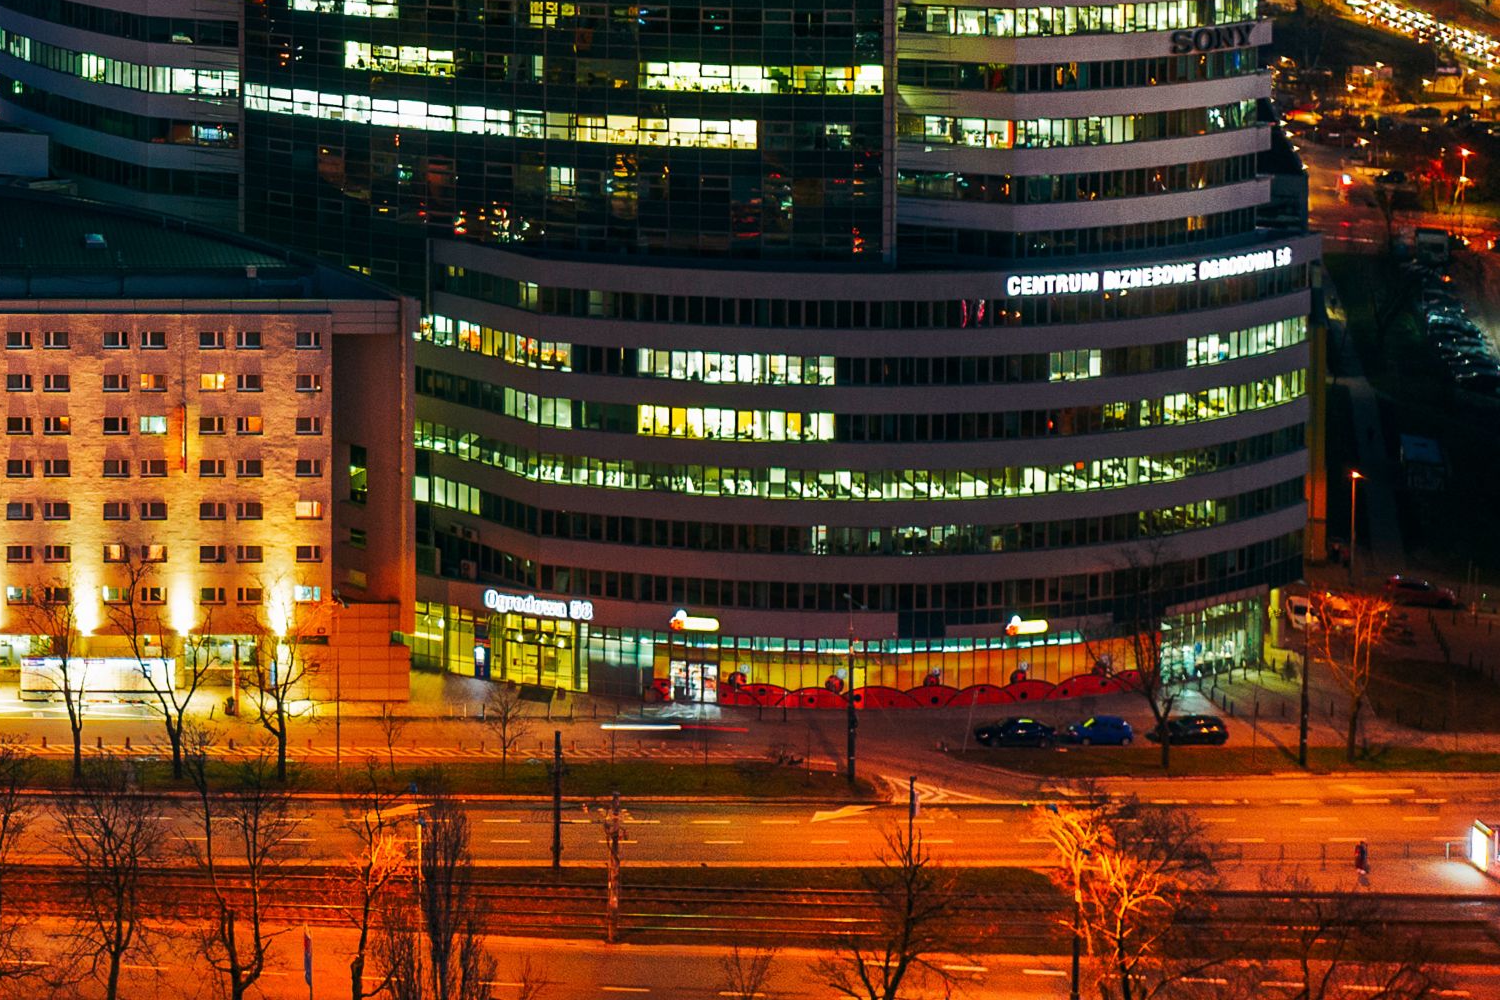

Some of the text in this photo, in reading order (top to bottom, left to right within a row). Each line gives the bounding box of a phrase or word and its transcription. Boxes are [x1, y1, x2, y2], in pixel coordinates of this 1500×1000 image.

[1171, 22, 1256, 54] SONY
[1007, 271, 1099, 297] CENTRUM
[1102, 262, 1197, 291] BIZNESOWE
[1198, 250, 1275, 281] OGRODOWA
[485, 588, 594, 621] Ogrodowa 58
